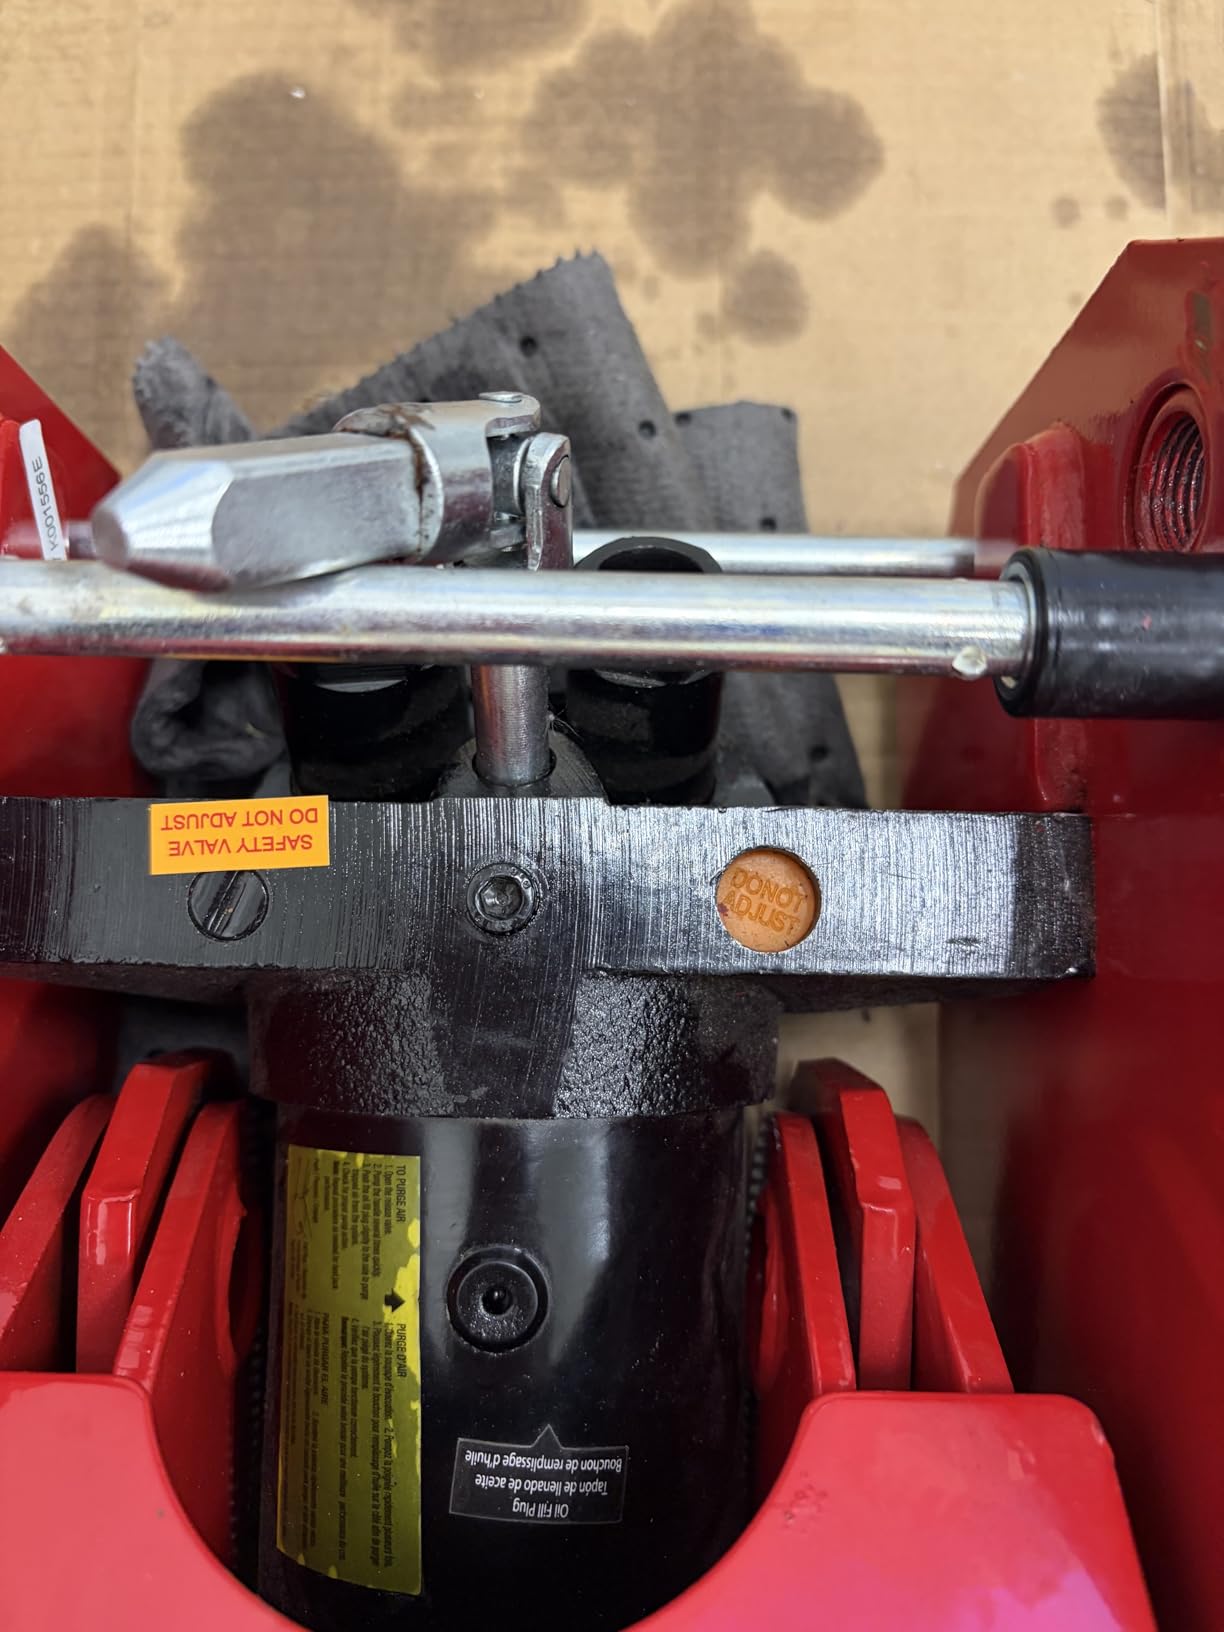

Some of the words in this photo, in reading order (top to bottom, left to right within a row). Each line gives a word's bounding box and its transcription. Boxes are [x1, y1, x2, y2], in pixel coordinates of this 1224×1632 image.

[31, 456, 59, 551] K001556E
[160, 811, 237, 831] ADJUST
[242, 809, 283, 827] NOT
[289, 807, 318, 825] DO
[168, 838, 231, 857] VALVE
[236, 834, 313, 853] SAFETY
[722, 890, 800, 935] ADJUST
[396, 1165, 406, 1175] TO
[396, 1178, 406, 1206] PURGE
[396, 1208, 406, 1222] AIR
[396, 1324, 406, 1352] PURGE
[396, 1354, 406, 1378] D'AIR
[465, 1450, 500, 1469] d'huile
[502, 1452, 564, 1472] remplissage
[565, 1458, 579, 1474] de
[581, 1458, 622, 1474] Bouchon
[475, 1474, 507, 1490] aceite
[508, 1478, 522, 1493] de
[524, 1479, 562, 1496] llenado
[564, 1481, 577, 1496] de
[579, 1480, 608, 1496] Tapón
[512, 1498, 536, 1517] Plug
[537, 1502, 553, 1518] Fill
[554, 1503, 569, 1519] Oil
